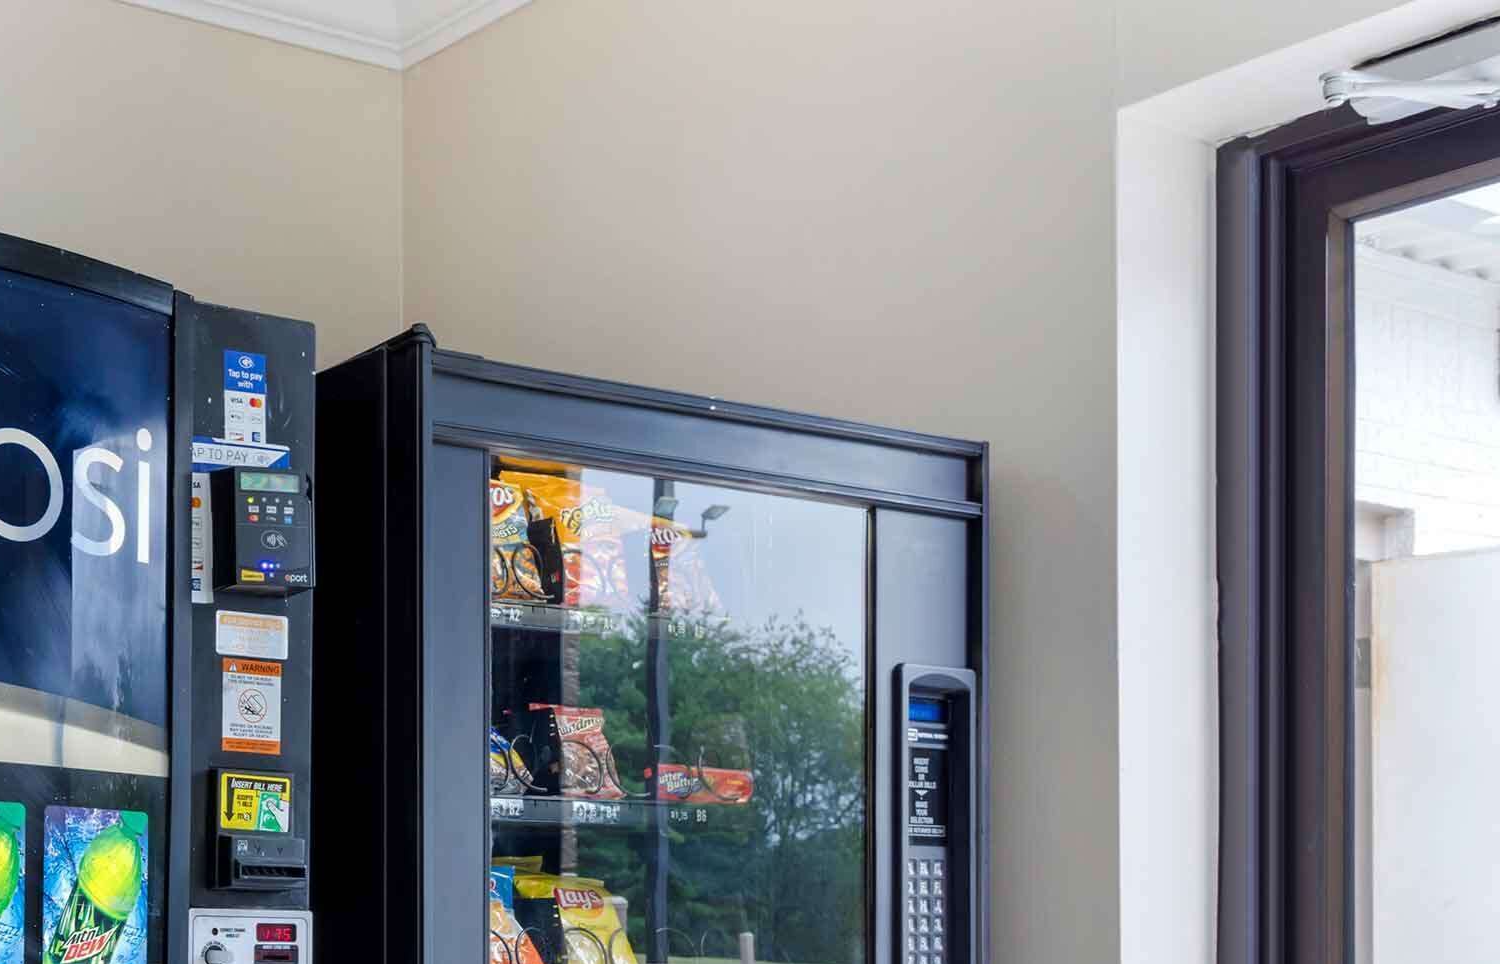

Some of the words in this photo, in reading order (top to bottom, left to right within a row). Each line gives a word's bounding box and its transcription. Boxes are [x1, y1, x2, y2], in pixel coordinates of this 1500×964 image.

[228, 369, 240, 379] Tap
[241, 370, 249, 379] to
[250, 372, 263, 381] pay
[226, 449, 248, 462] PAY
[241, 662, 280, 674] WARNING
